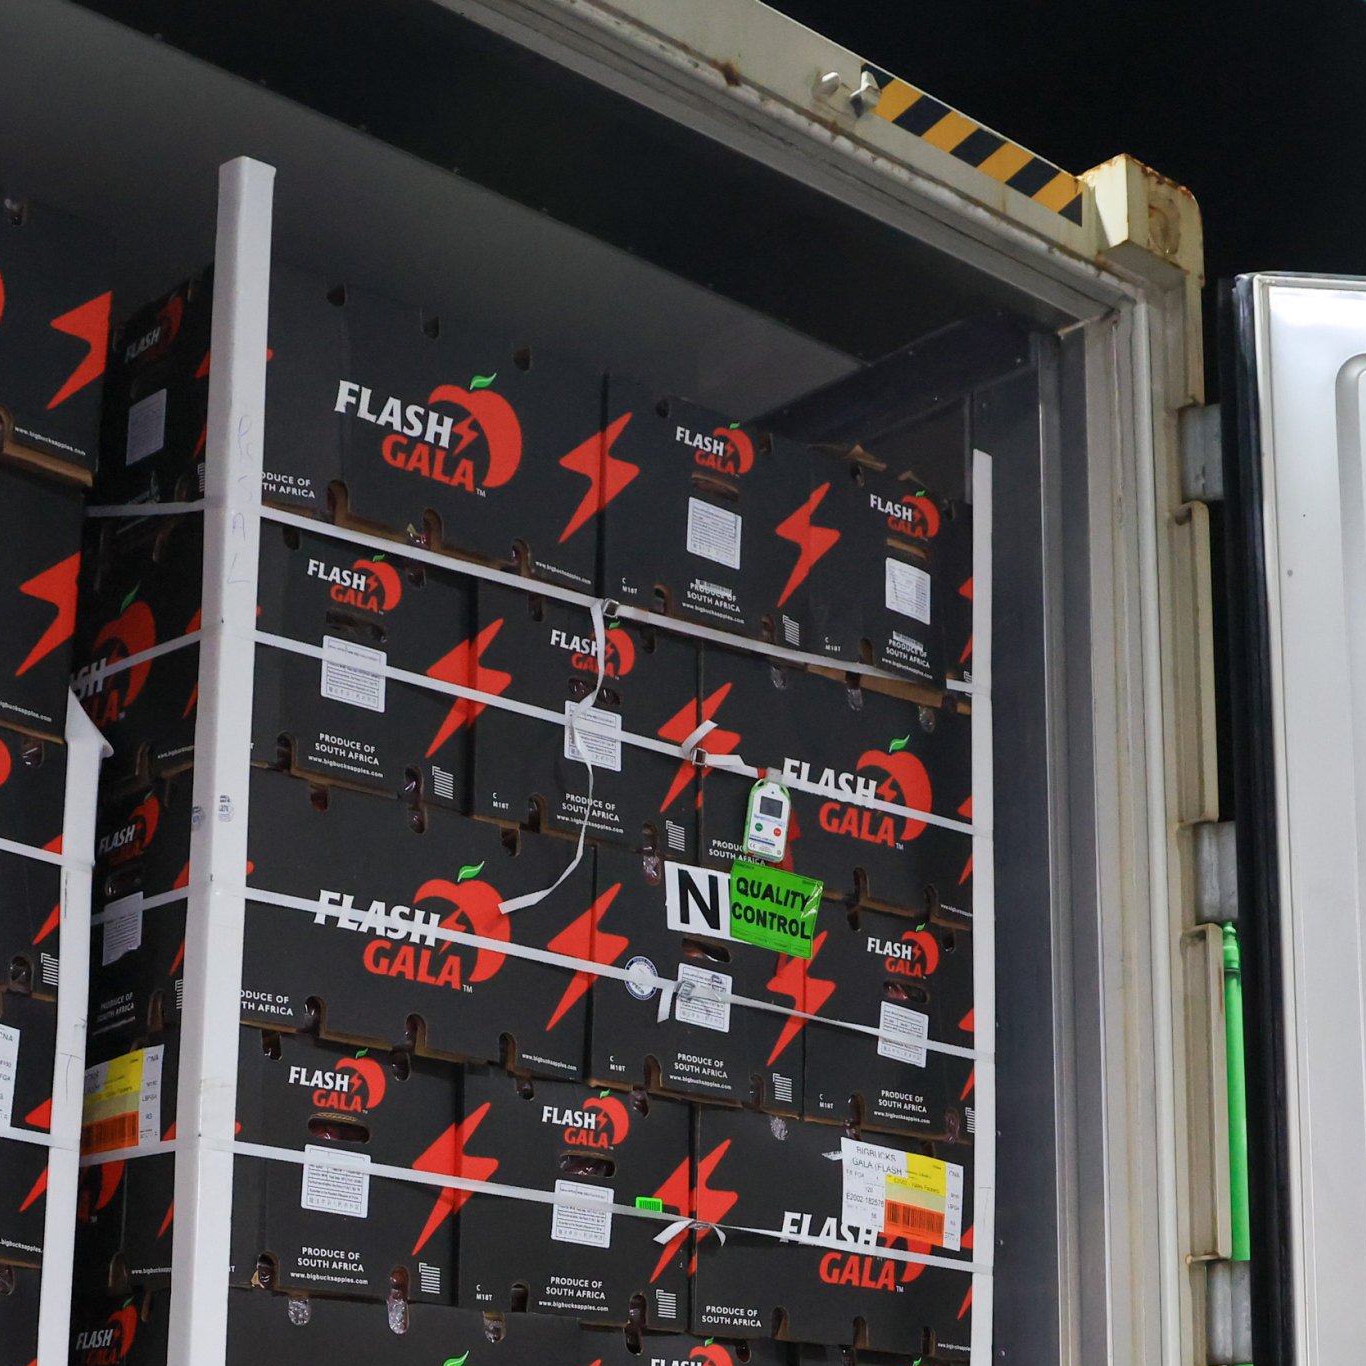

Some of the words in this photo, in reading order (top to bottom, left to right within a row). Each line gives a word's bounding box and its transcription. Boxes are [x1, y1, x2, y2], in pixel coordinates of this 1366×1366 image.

[334, 380, 453, 448] FLASH
[675, 426, 724, 457] FLASH
[382, 434, 475, 492] GALA
[695, 450, 735, 475] GALA
[870, 494, 913, 521] FLASH
[888, 515, 924, 539] GALA
[307, 559, 366, 592] FLASH
[330, 586, 379, 612] GALA
[819, 802, 896, 847] GALA
[737, 877, 810, 911] QUALITY
[313, 889, 441, 946] FLASH
[732, 902, 811, 939] CONTROL
[867, 937, 912, 960] FLASH
[363, 939, 461, 990] GALA
[886, 957, 922, 977] GALA
[288, 1065, 349, 1092] FLASH
[313, 1089, 362, 1112] GALA
[542, 1106, 596, 1129] FLASH
[564, 1125, 608, 1149] GALA
[297, 1257, 330, 1269] SOUTH
[332, 1261, 364, 1272] AFRICA
[302, 1247, 345, 1259] PRODUCE
[347, 1252, 360, 1260] OF
[819, 1252, 896, 1291] GALA
[76, 1329, 114, 1350] FLASH
